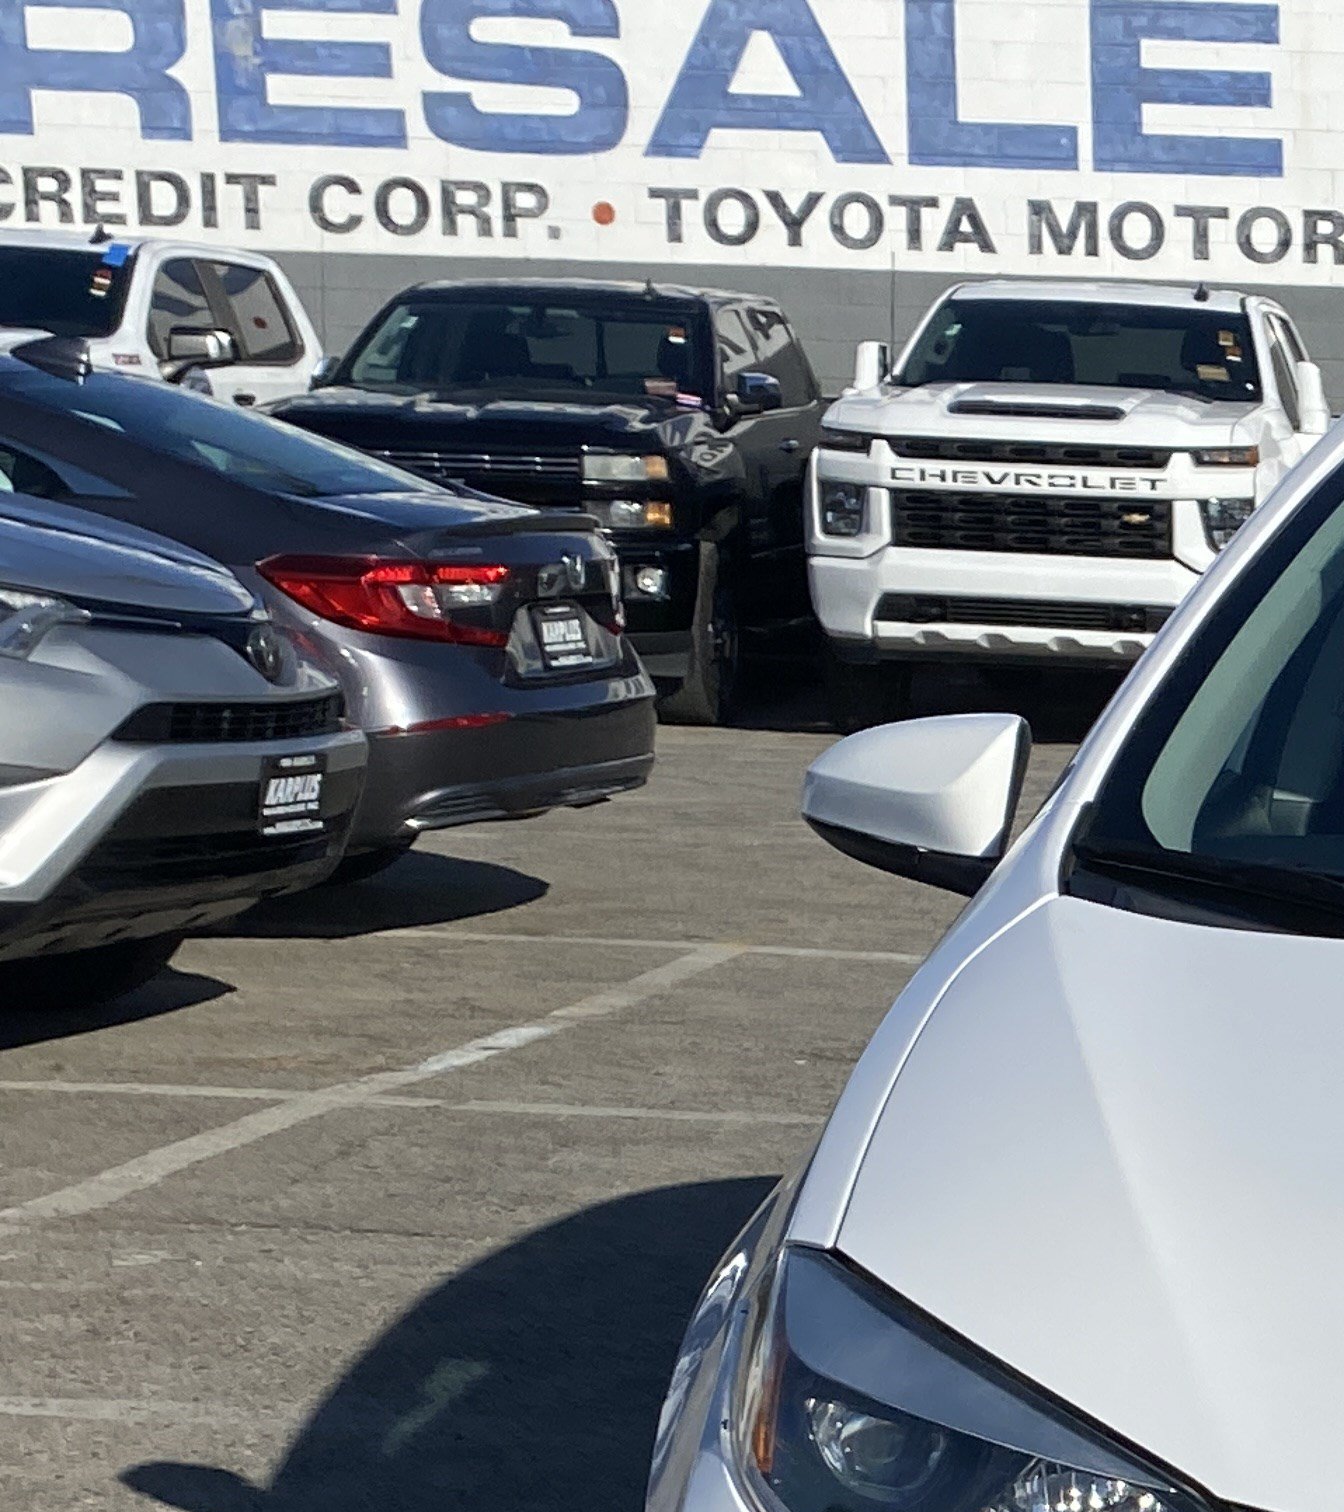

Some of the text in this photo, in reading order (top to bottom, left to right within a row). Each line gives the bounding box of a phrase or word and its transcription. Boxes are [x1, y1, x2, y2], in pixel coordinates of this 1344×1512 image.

[0, 0, 1284, 177] RESALE
[309, 174, 562, 240] CORP.
[648, 186, 996, 255] TOYOTA
[890, 466, 1168, 492] CHEVROLET
